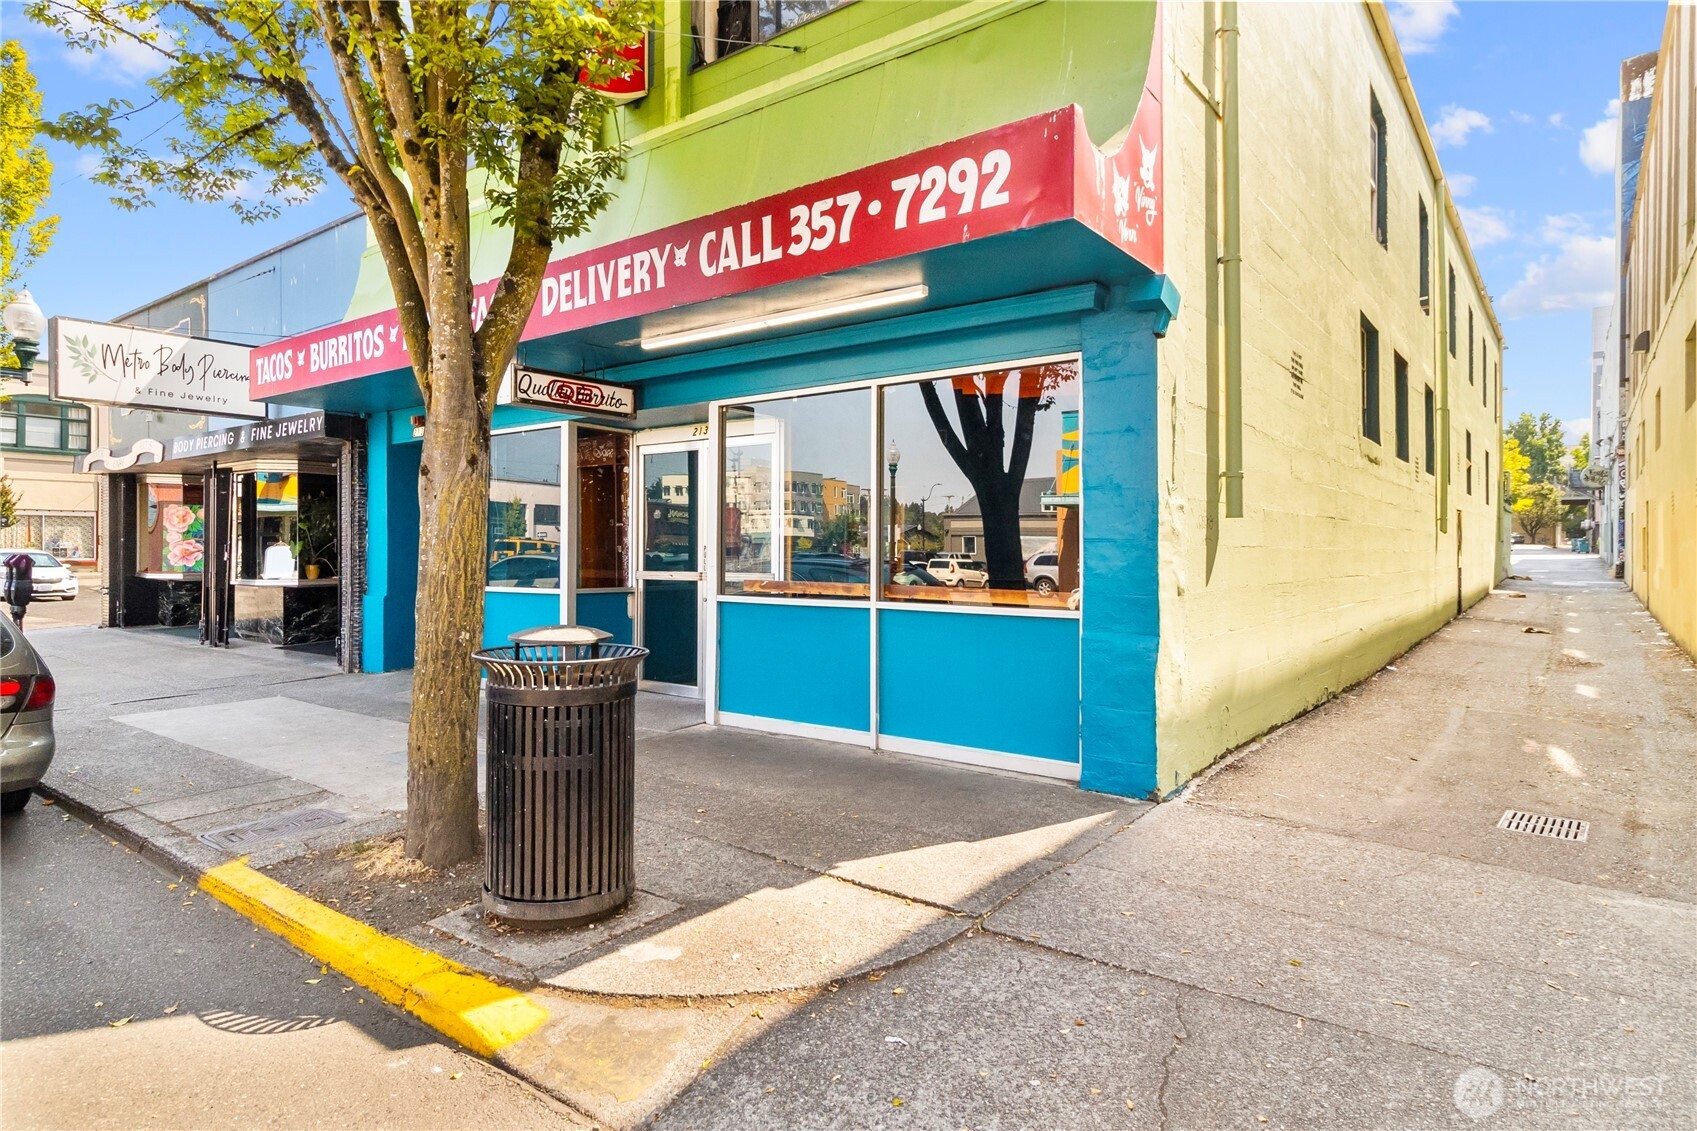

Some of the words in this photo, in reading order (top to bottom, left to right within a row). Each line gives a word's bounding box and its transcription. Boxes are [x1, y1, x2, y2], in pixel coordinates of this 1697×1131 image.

[256, 349, 293, 386] TACOS
[309, 324, 385, 373] BURRITOS
[541, 243, 672, 317] DELIVERY
[699, 214, 782, 277] CALL
[101, 343, 150, 379] Metro
[153, 344, 194, 385] Body
[134, 386, 141, 395] &
[148, 388, 174, 398] Fine
[180, 392, 228, 405] Jewelry
[173, 439, 194, 454] BODY
[195, 432, 234, 450] PIERCING
[239, 430, 246, 443] &
[250, 425, 273, 441] FINE
[275, 416, 323, 438] JEWELRY
[692, 425, 708, 436] 213
